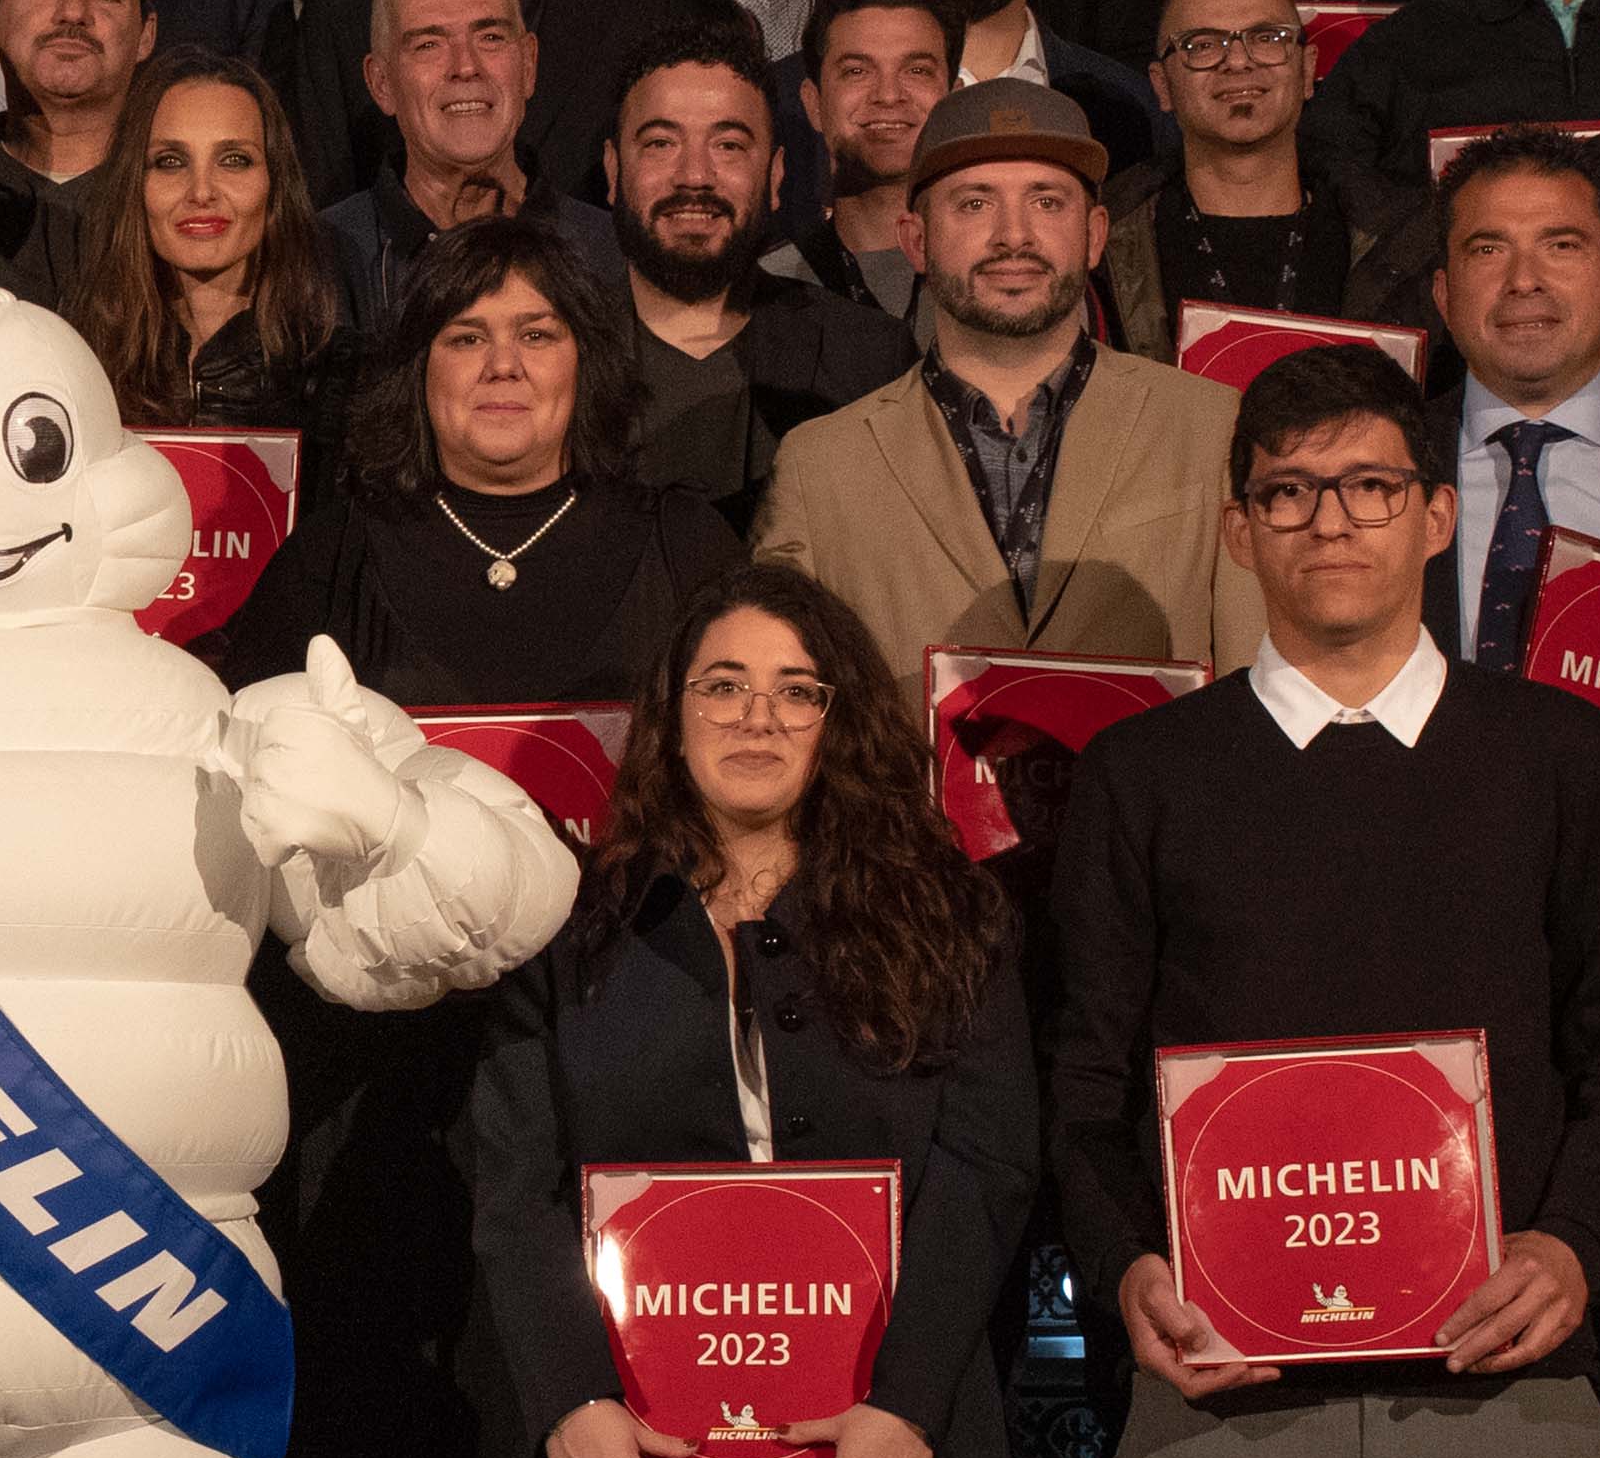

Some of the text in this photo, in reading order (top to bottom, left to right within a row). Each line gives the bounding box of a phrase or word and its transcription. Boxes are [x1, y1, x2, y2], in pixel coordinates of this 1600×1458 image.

[1218, 1159, 1442, 1201] MICHELIN
[1285, 1211, 1380, 1247] 2023
[635, 1280, 852, 1318] MICHELIN
[1300, 1310, 1375, 1325] MICHELIN
[697, 1333, 790, 1365] 2023
